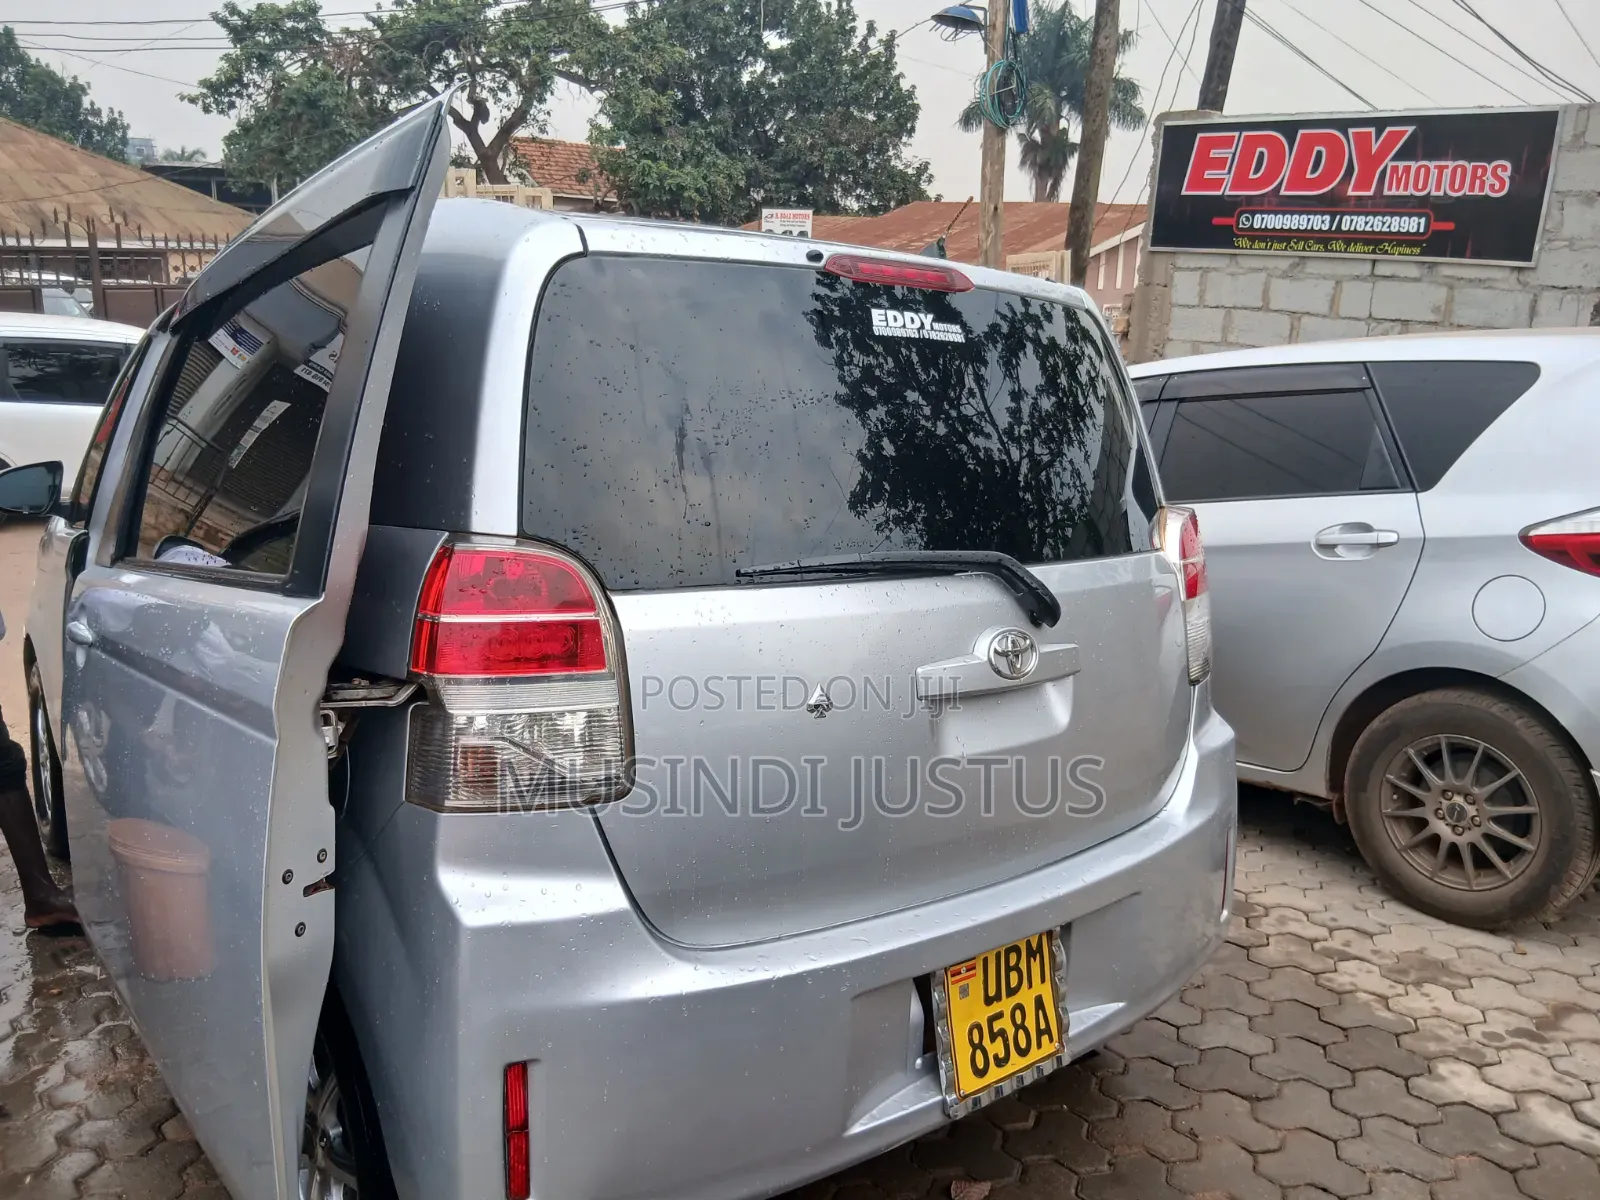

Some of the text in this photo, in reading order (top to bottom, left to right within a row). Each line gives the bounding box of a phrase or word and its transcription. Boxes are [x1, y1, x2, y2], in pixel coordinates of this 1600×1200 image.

[1181, 125, 1512, 198] EDDY MOTORS
[1253, 214, 1426, 233] 0700989703 / 0782628981
[1271, 240, 1287, 251] just
[1287, 239, 1304, 251] Sell
[1305, 240, 1325, 251] Cars,
[1328, 240, 1347, 252] We
[1347, 242, 1374, 253] deliver
[871, 308, 962, 333] EDDY MOTORS
[982, 935, 1046, 1007] UBM
[967, 994, 1054, 1078] 858A
